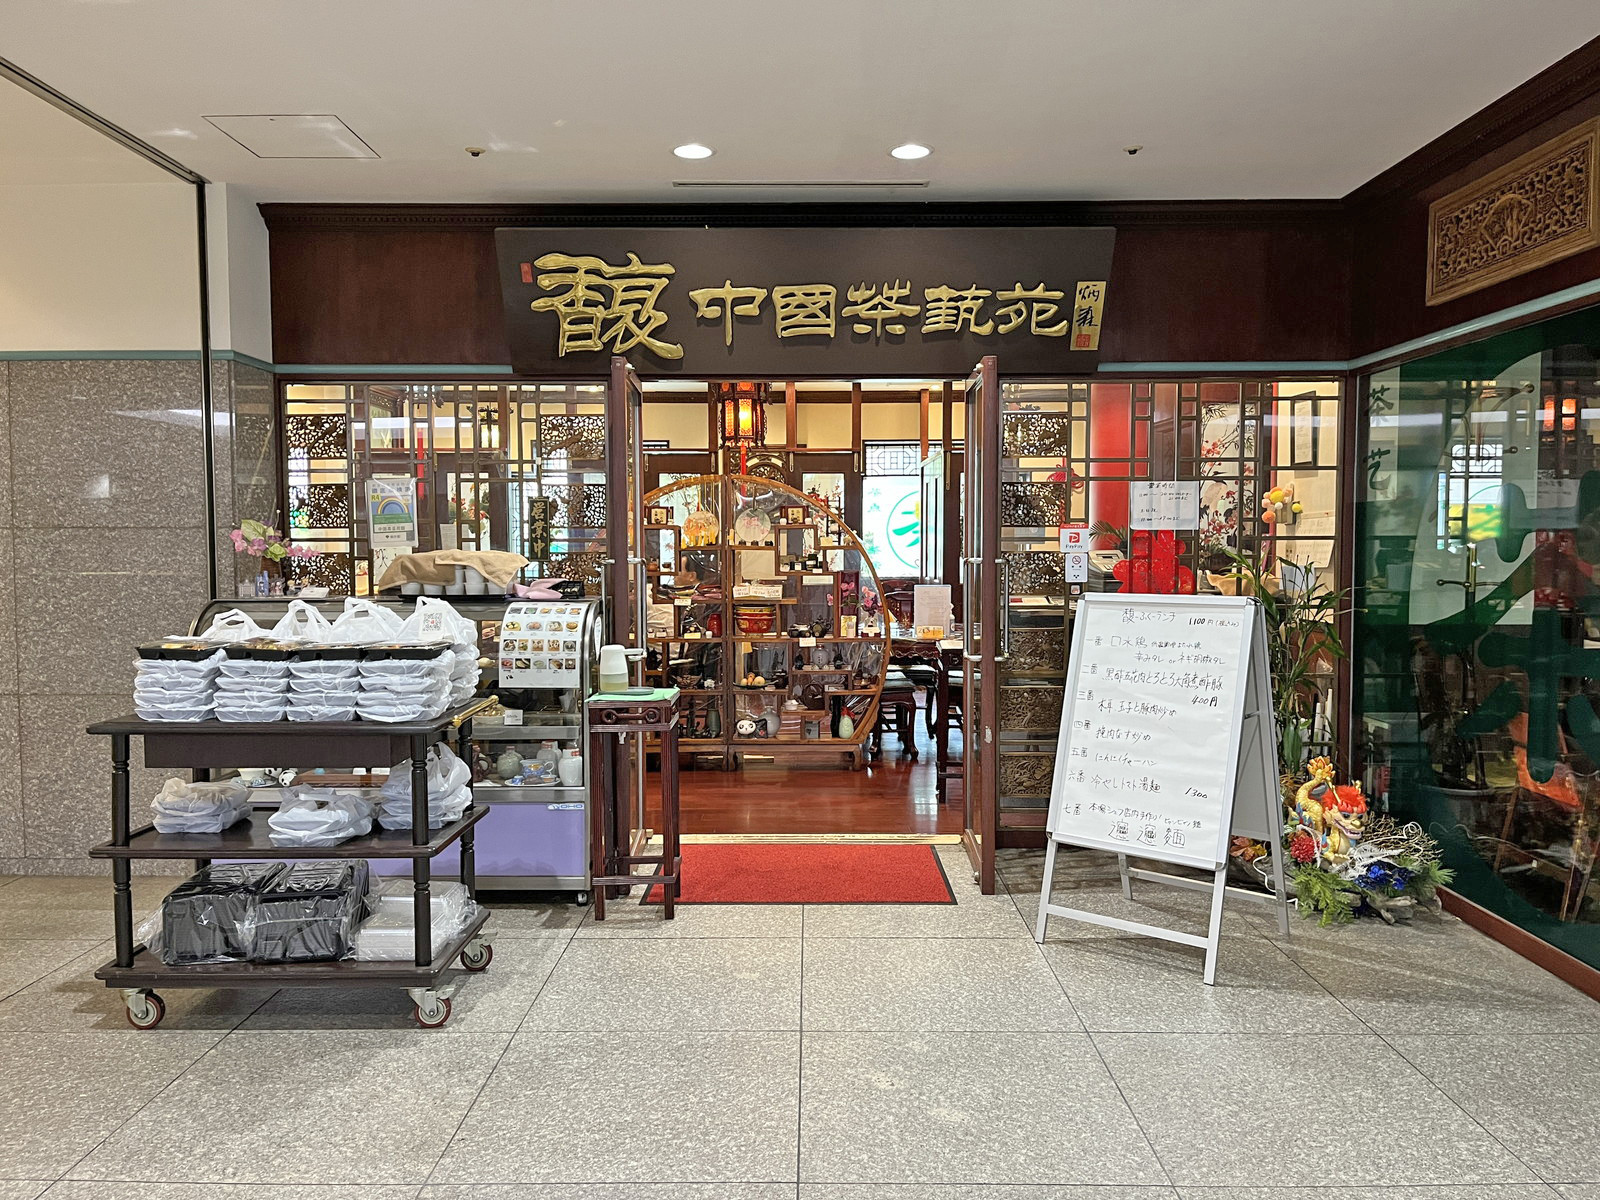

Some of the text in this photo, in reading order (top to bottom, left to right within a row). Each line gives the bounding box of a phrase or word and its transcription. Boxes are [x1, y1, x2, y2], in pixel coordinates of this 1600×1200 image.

[531, 501, 547, 558] 営業中
[1067, 769, 1086, 783] 六番
